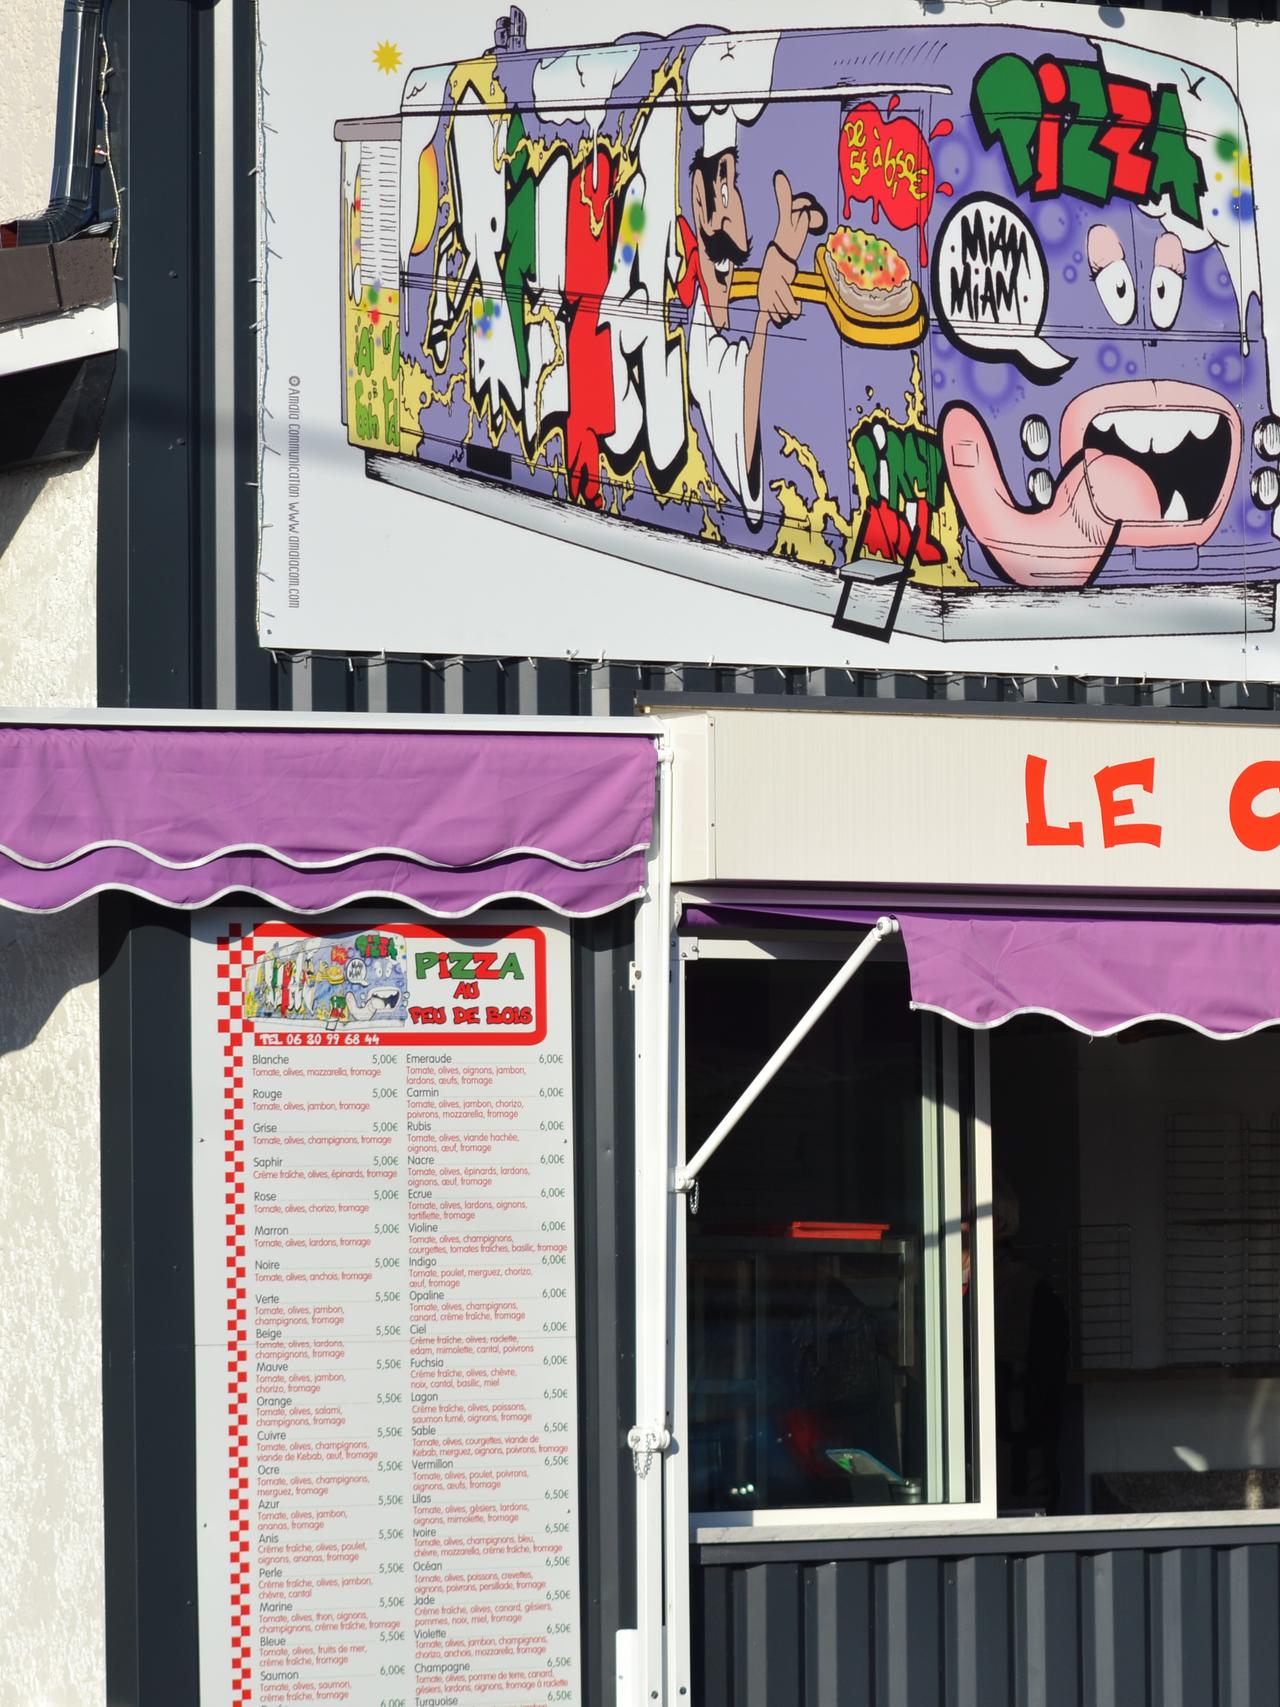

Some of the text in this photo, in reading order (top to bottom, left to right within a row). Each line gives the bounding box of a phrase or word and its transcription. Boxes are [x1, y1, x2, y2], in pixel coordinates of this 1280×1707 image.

[288, 423, 301, 498] Communication
[1025, 754, 1162, 849] LE
[453, 981, 480, 999] AU
[408, 1006, 447, 1024] FEU
[452, 1006, 481, 1024] DE
[259, 1033, 283, 1045] TEL
[286, 1033, 302, 1045] 06
[326, 1033, 340, 1045] 99
[344, 1033, 360, 1045] 68
[364, 1033, 380, 1045] 44
[252, 1054, 396, 1066] Blanche 5,00€
[406, 1054, 562, 1064] Emeraude 6,00€
[351, 1068, 381, 1078] fromage
[462, 1077, 493, 1086] fromage
[252, 1088, 398, 1102] Rouge 5,00€
[406, 1088, 564, 1098] Carmin 6,00€
[340, 1102, 370, 1111] fromage
[487, 1110, 518, 1120] fromage
[252, 1122, 398, 1134] Grise 5,00€
[408, 1120, 564, 1132] Rubis 6,00€
[361, 1136, 391, 1146] fromage
[252, 1156, 398, 1170] Saphir 5,00€
[408, 1154, 564, 1164] Nacre 6,00€
[367, 1170, 397, 1180] fromage
[254, 1190, 398, 1202] Rose 5,00€
[408, 1188, 564, 1198] Ecrue 6,00€
[339, 1205, 369, 1214] fromage
[254, 1224, 400, 1236] Marron 5,00€
[408, 1220, 566, 1232] Violine 6,00€
[340, 1238, 371, 1248] fromage
[254, 1258, 400, 1270] Noire 5,00€
[408, 1254, 566, 1268] Indigo 6,00€
[256, 1292, 400, 1304] Verte 5,50€
[410, 1288, 566, 1302] Opaline 6,00€
[256, 1326, 400, 1340] Beige 5,50€
[410, 1322, 566, 1334] Ciel 6,00€
[256, 1358, 402, 1372] Mauve 5,50€
[410, 1354, 568, 1368] Fuchsia 6,00€
[256, 1392, 402, 1408] Orange 5,50€
[410, 1388, 568, 1404] Lagon 6,50€
[258, 1426, 402, 1440] Cuivre 5,50€
[412, 1422, 568, 1436] Sable 6,50€
[258, 1460, 402, 1476] Ocre 5,50€
[412, 1456, 568, 1470] Vermillon 6,50€
[258, 1496, 402, 1510] Azur 5,50€
[412, 1488, 568, 1504] Lilas 6,50€
[258, 1528, 404, 1544] Anis 5,50€
[412, 1522, 568, 1538] Ivoire 6,50€
[260, 1562, 404, 1578] Perle 5,50€
[412, 1556, 570, 1572] Océan 6,50€
[260, 1596, 404, 1612] Marine 5,50€
[414, 1590, 570, 1606] Jade 6,50€
[260, 1630, 404, 1646] Bleue 5,50€
[414, 1624, 570, 1640] Violette 6,50€
[414, 1656, 570, 1674] Champagne 6,50€
[260, 1666, 404, 1680] Saumon 6,00€
[548, 1690, 570, 1700] 6,50€
